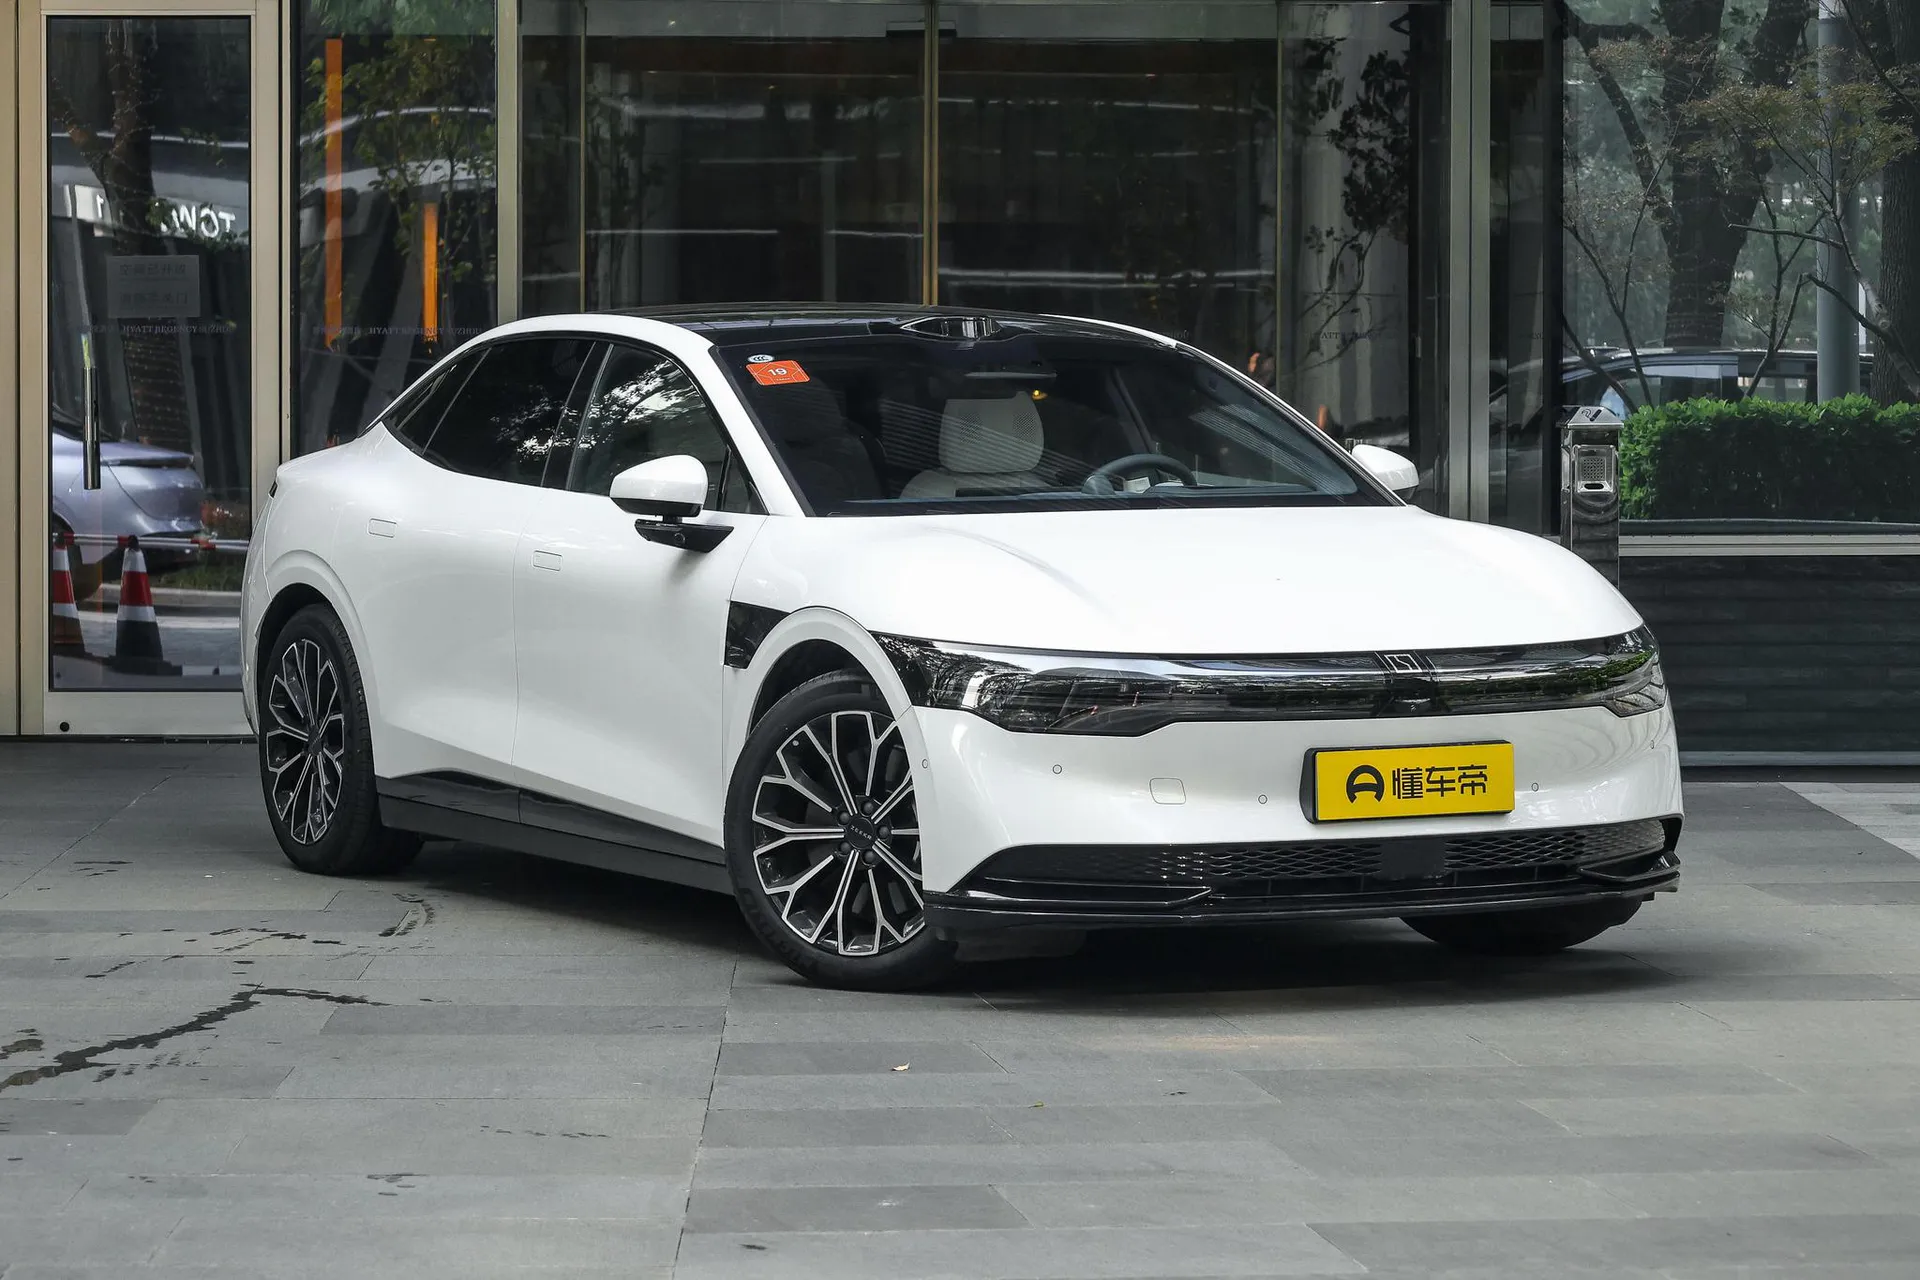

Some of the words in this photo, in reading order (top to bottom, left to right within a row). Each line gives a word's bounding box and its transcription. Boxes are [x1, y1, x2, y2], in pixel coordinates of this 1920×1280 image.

[122, 324, 153, 334] HYATT
[767, 368, 787, 376] 19
[1391, 764, 1488, 800] 懂车帝
